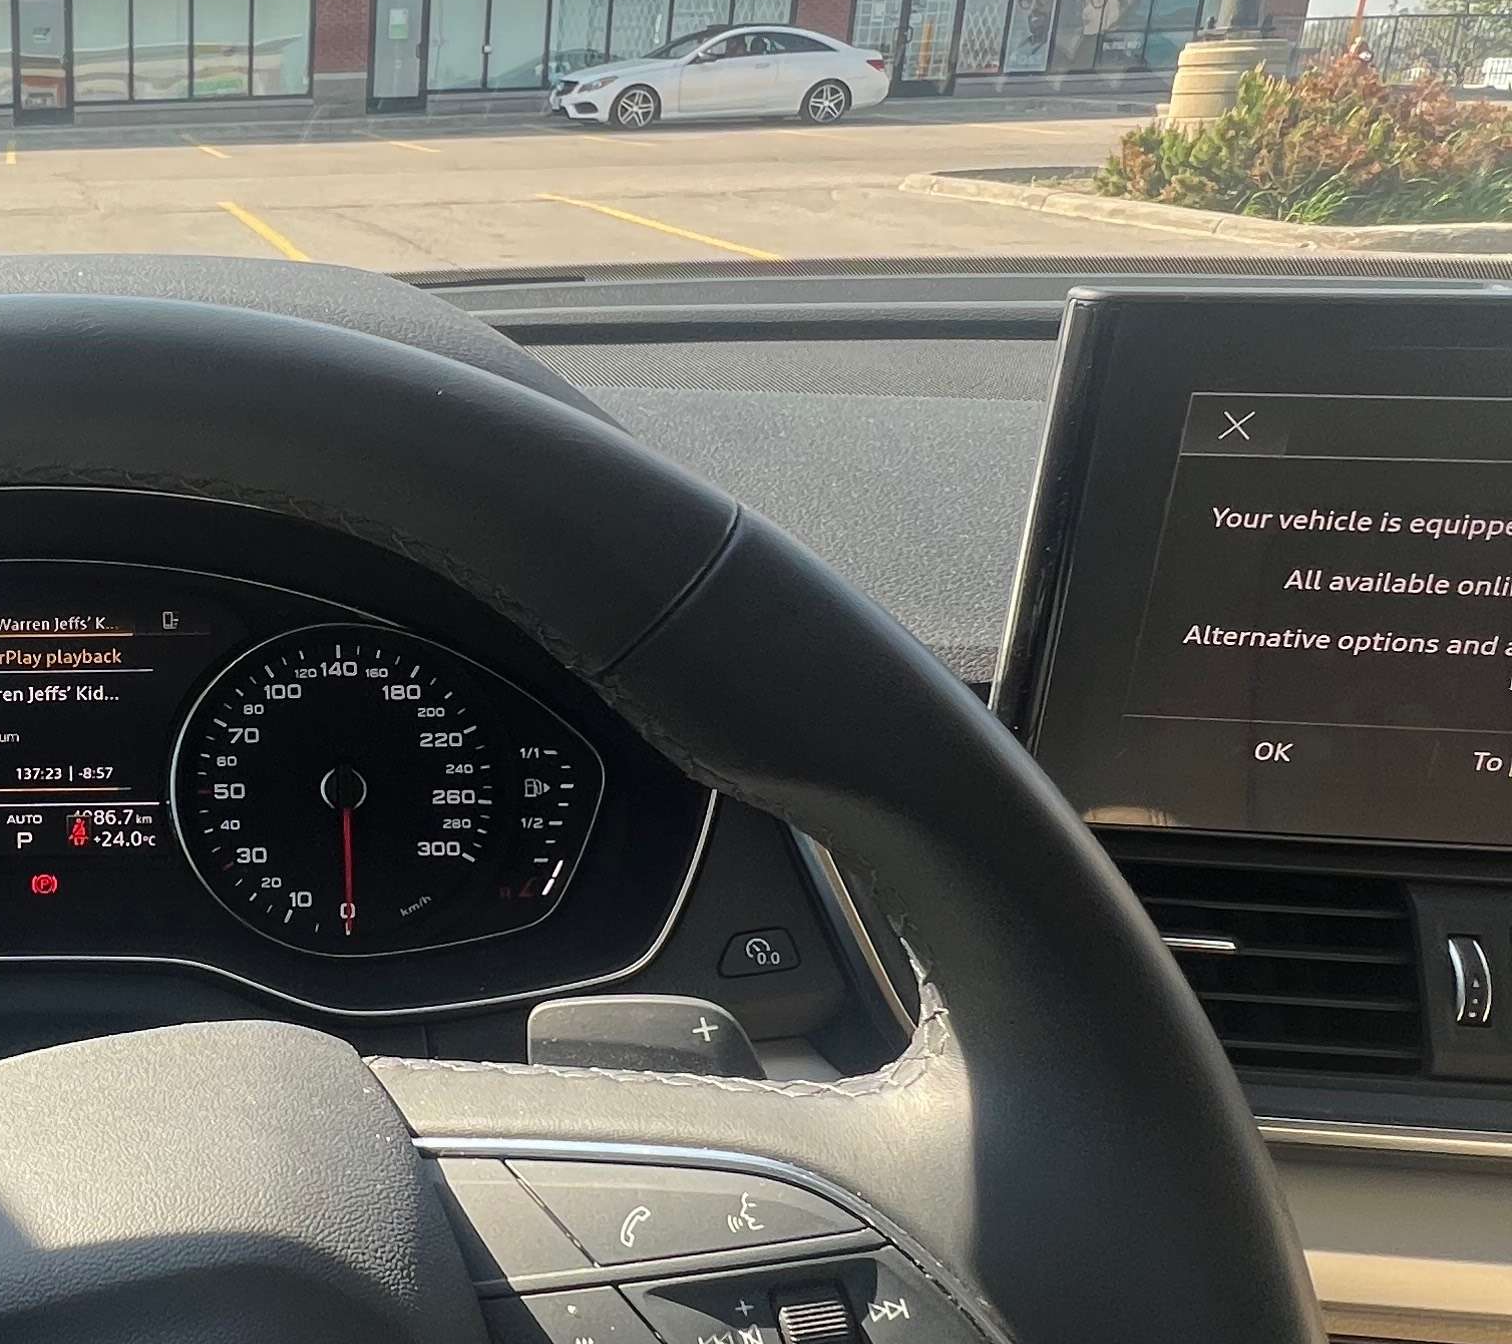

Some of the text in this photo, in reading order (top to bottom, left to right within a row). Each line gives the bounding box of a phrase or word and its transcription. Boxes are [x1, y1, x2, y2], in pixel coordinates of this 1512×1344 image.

[1212, 507, 1273, 530] Your
[1279, 509, 1373, 533] vehicle
[1380, 511, 1402, 534] is
[1284, 569, 1512, 596] All available onli
[1183, 625, 1330, 650] Alternative
[1338, 632, 1438, 656] options
[1446, 635, 1500, 656] and
[46, 648, 122, 667] playback
[294, 668, 317, 678] 120
[320, 661, 358, 677] 140
[365, 668, 388, 678] 160
[264, 684, 302, 700] 100
[382, 684, 421, 700] 180
[243, 704, 264, 715] 80
[417, 707, 445, 718] 200
[228, 727, 260, 744] 70
[419, 733, 463, 748] 220
[520, 748, 539, 759] 1/1
[1254, 742, 1294, 763] OK
[216, 756, 237, 767] 60
[445, 764, 474, 774] 240
[1473, 751, 1503, 772] To
[16, 767, 62, 781] 137:23
[78, 767, 114, 780] -8:57
[213, 783, 245, 800] 50
[432, 790, 476, 805] 260
[7, 814, 43, 825] AUTO
[220, 819, 240, 830] 40
[442, 819, 472, 829] 280
[521, 817, 544, 829] 1/2
[17, 832, 33, 849] P
[236, 847, 267, 864] 30
[417, 841, 461, 857] 300
[261, 877, 282, 889] 20
[289, 891, 312, 907] 10
[400, 895, 431, 917] km/h
[340, 903, 356, 920] 0
